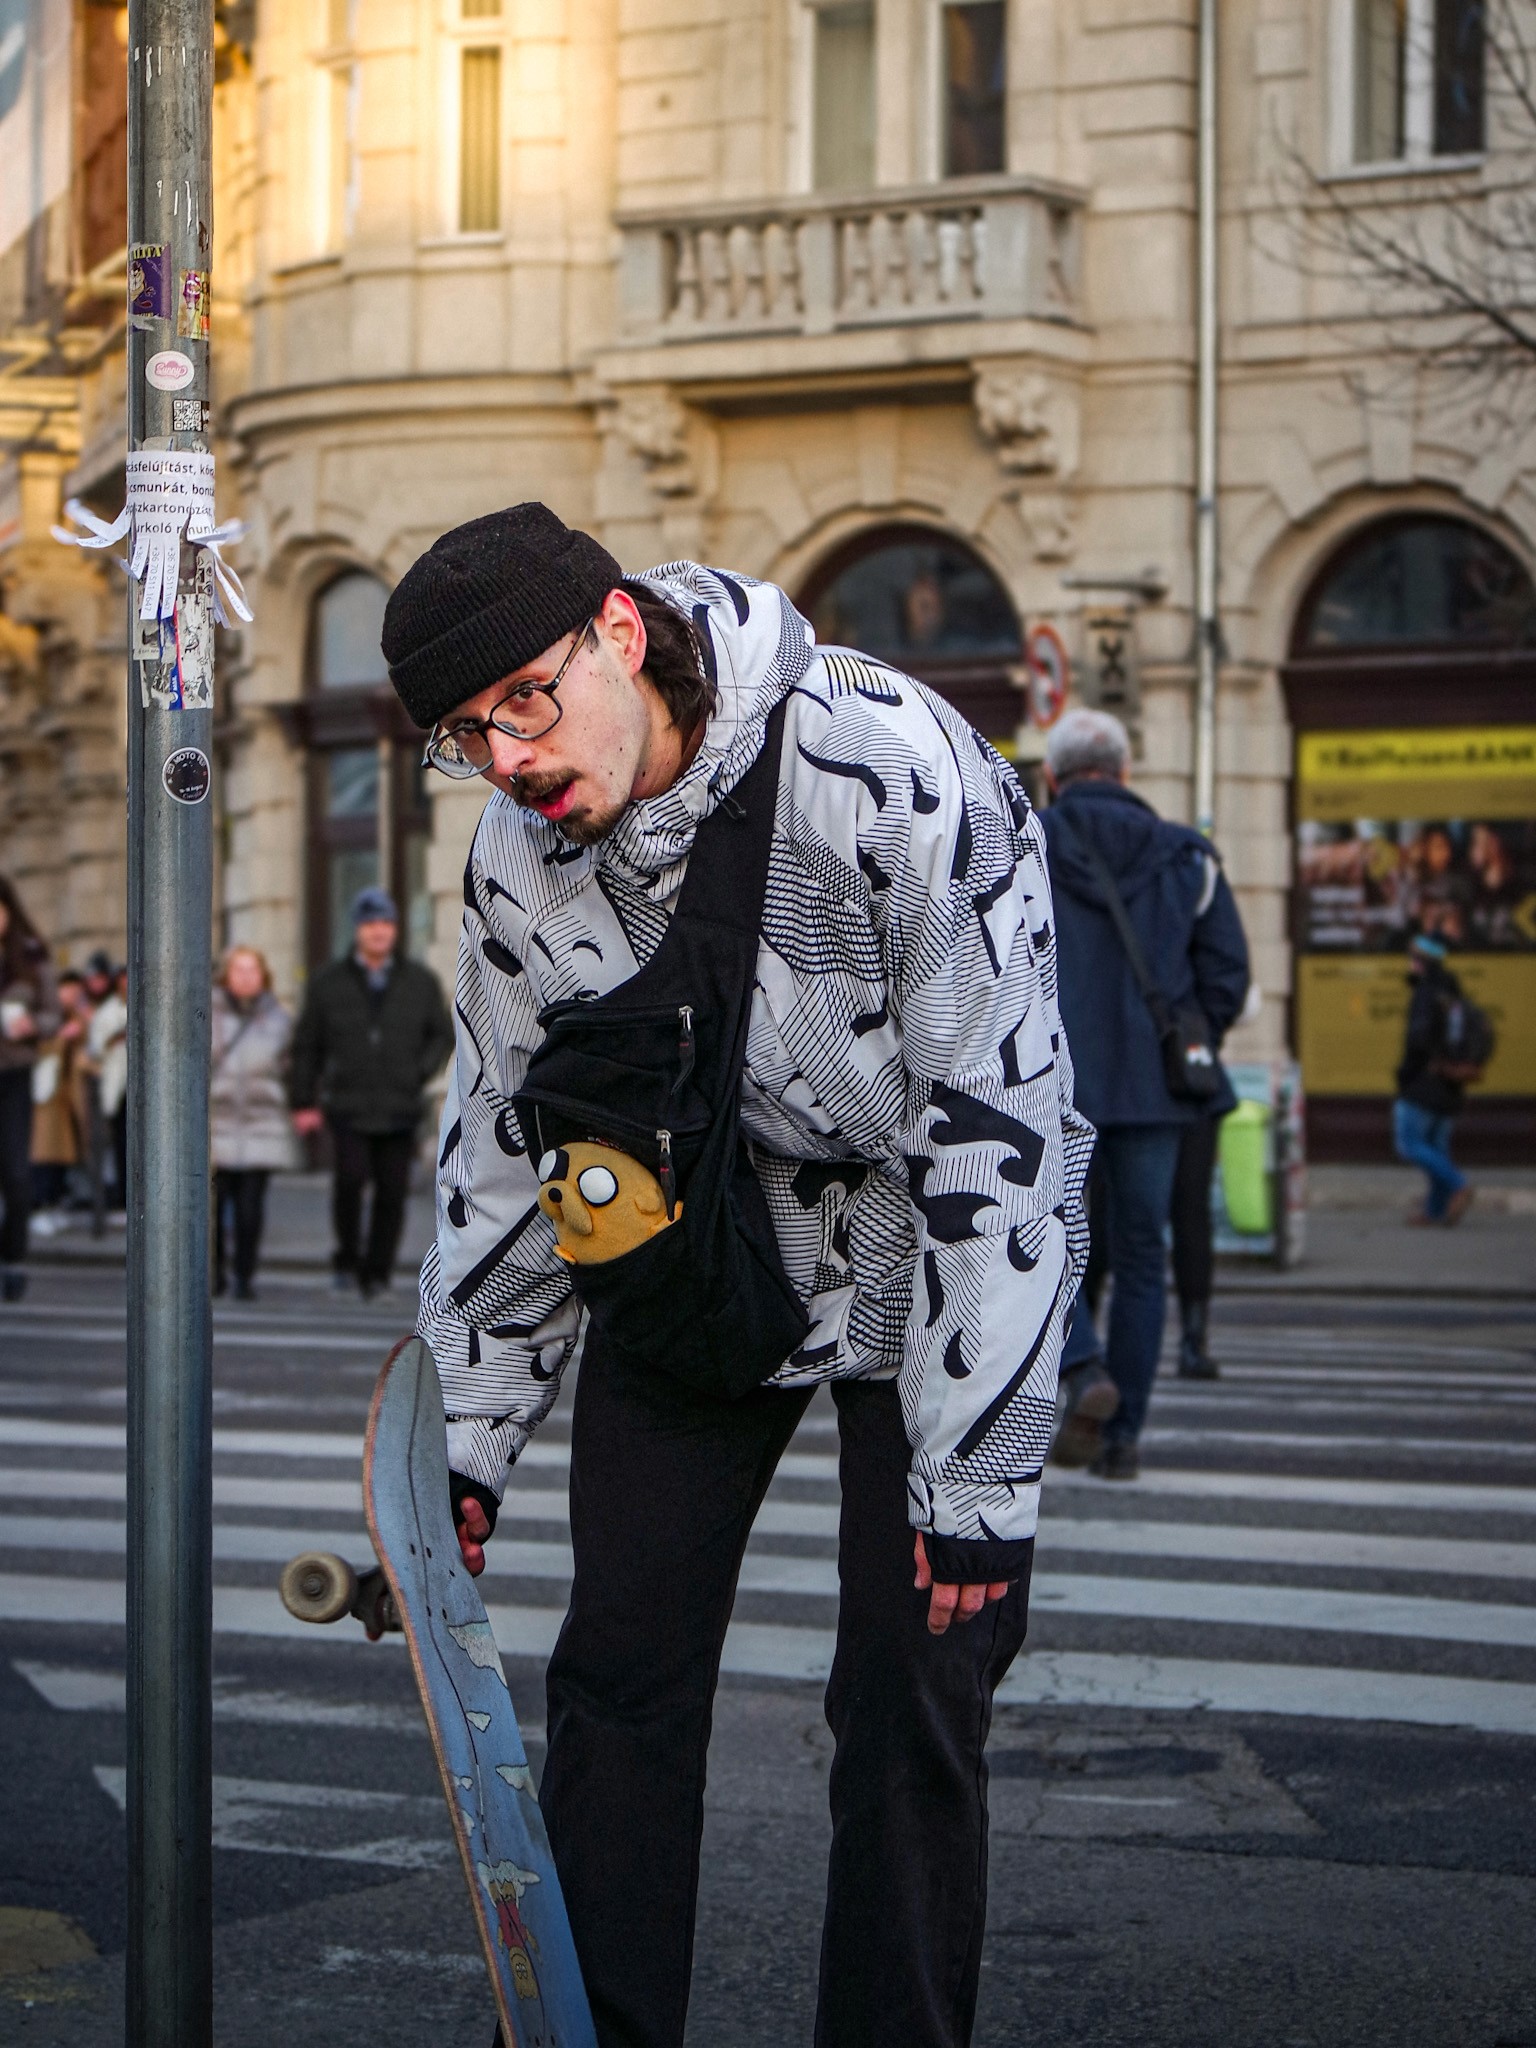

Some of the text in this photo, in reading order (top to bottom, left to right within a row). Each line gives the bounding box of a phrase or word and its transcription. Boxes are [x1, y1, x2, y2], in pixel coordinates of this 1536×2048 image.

[129, 482, 188, 495] csmunkát,
[136, 522, 172, 534] urkoló
[150, 563, 159, 574] 70
[167, 564, 175, 574] 70
[173, 752, 196, 764] MOTO
